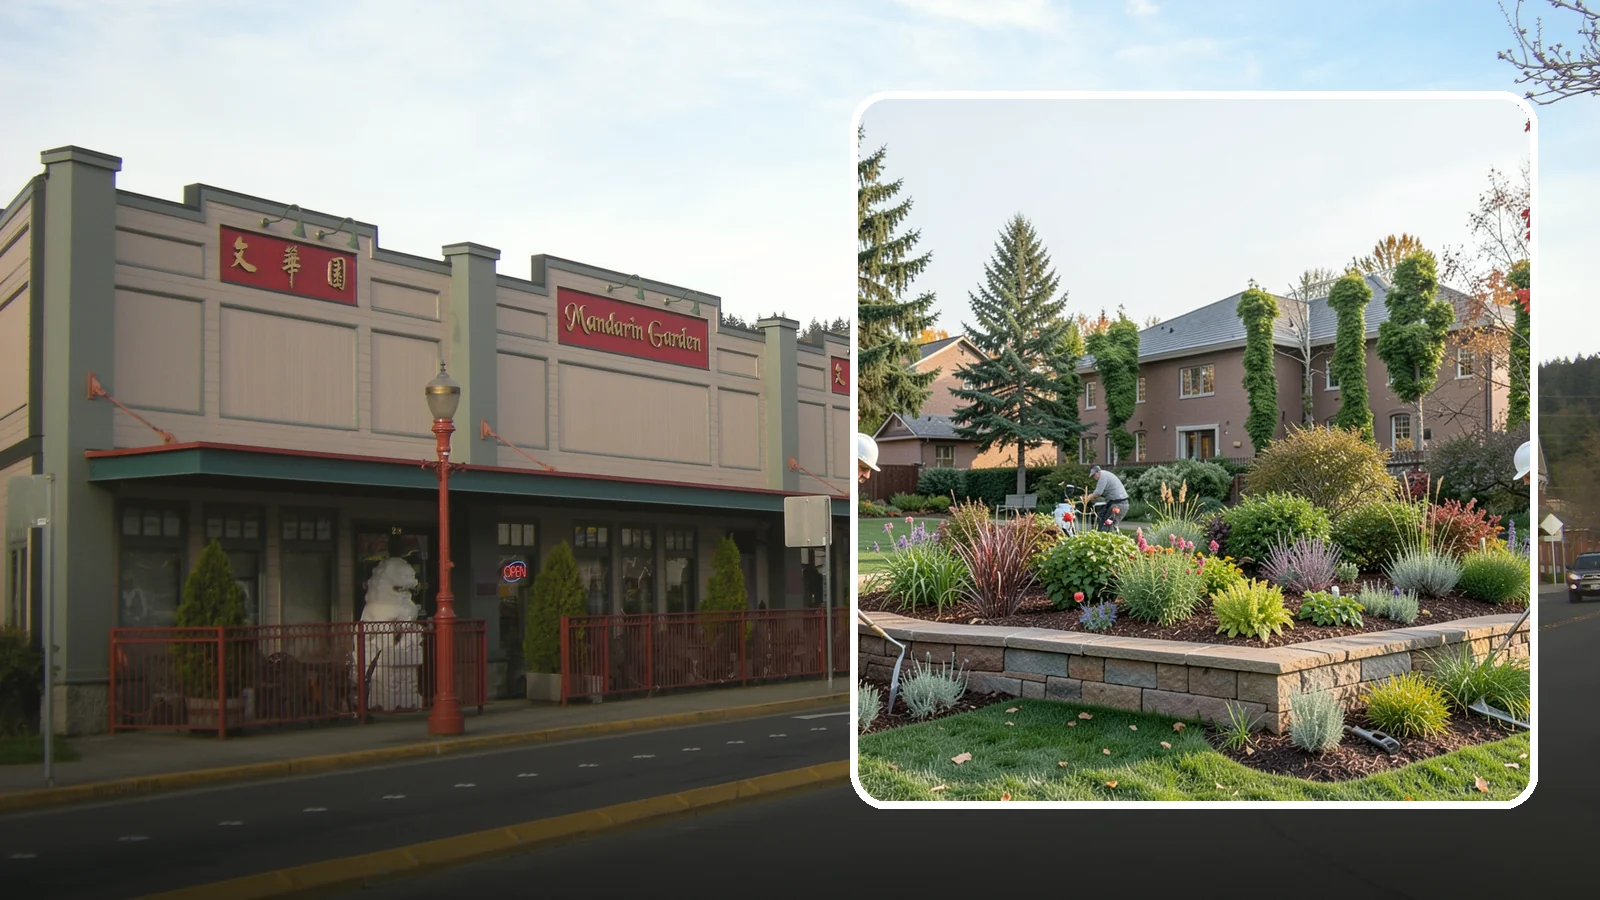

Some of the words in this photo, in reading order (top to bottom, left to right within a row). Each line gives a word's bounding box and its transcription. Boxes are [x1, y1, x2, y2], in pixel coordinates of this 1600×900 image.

[564, 302, 644, 341] Mandarin
[647, 320, 702, 352] Garden
[503, 565, 527, 578] OPEN
